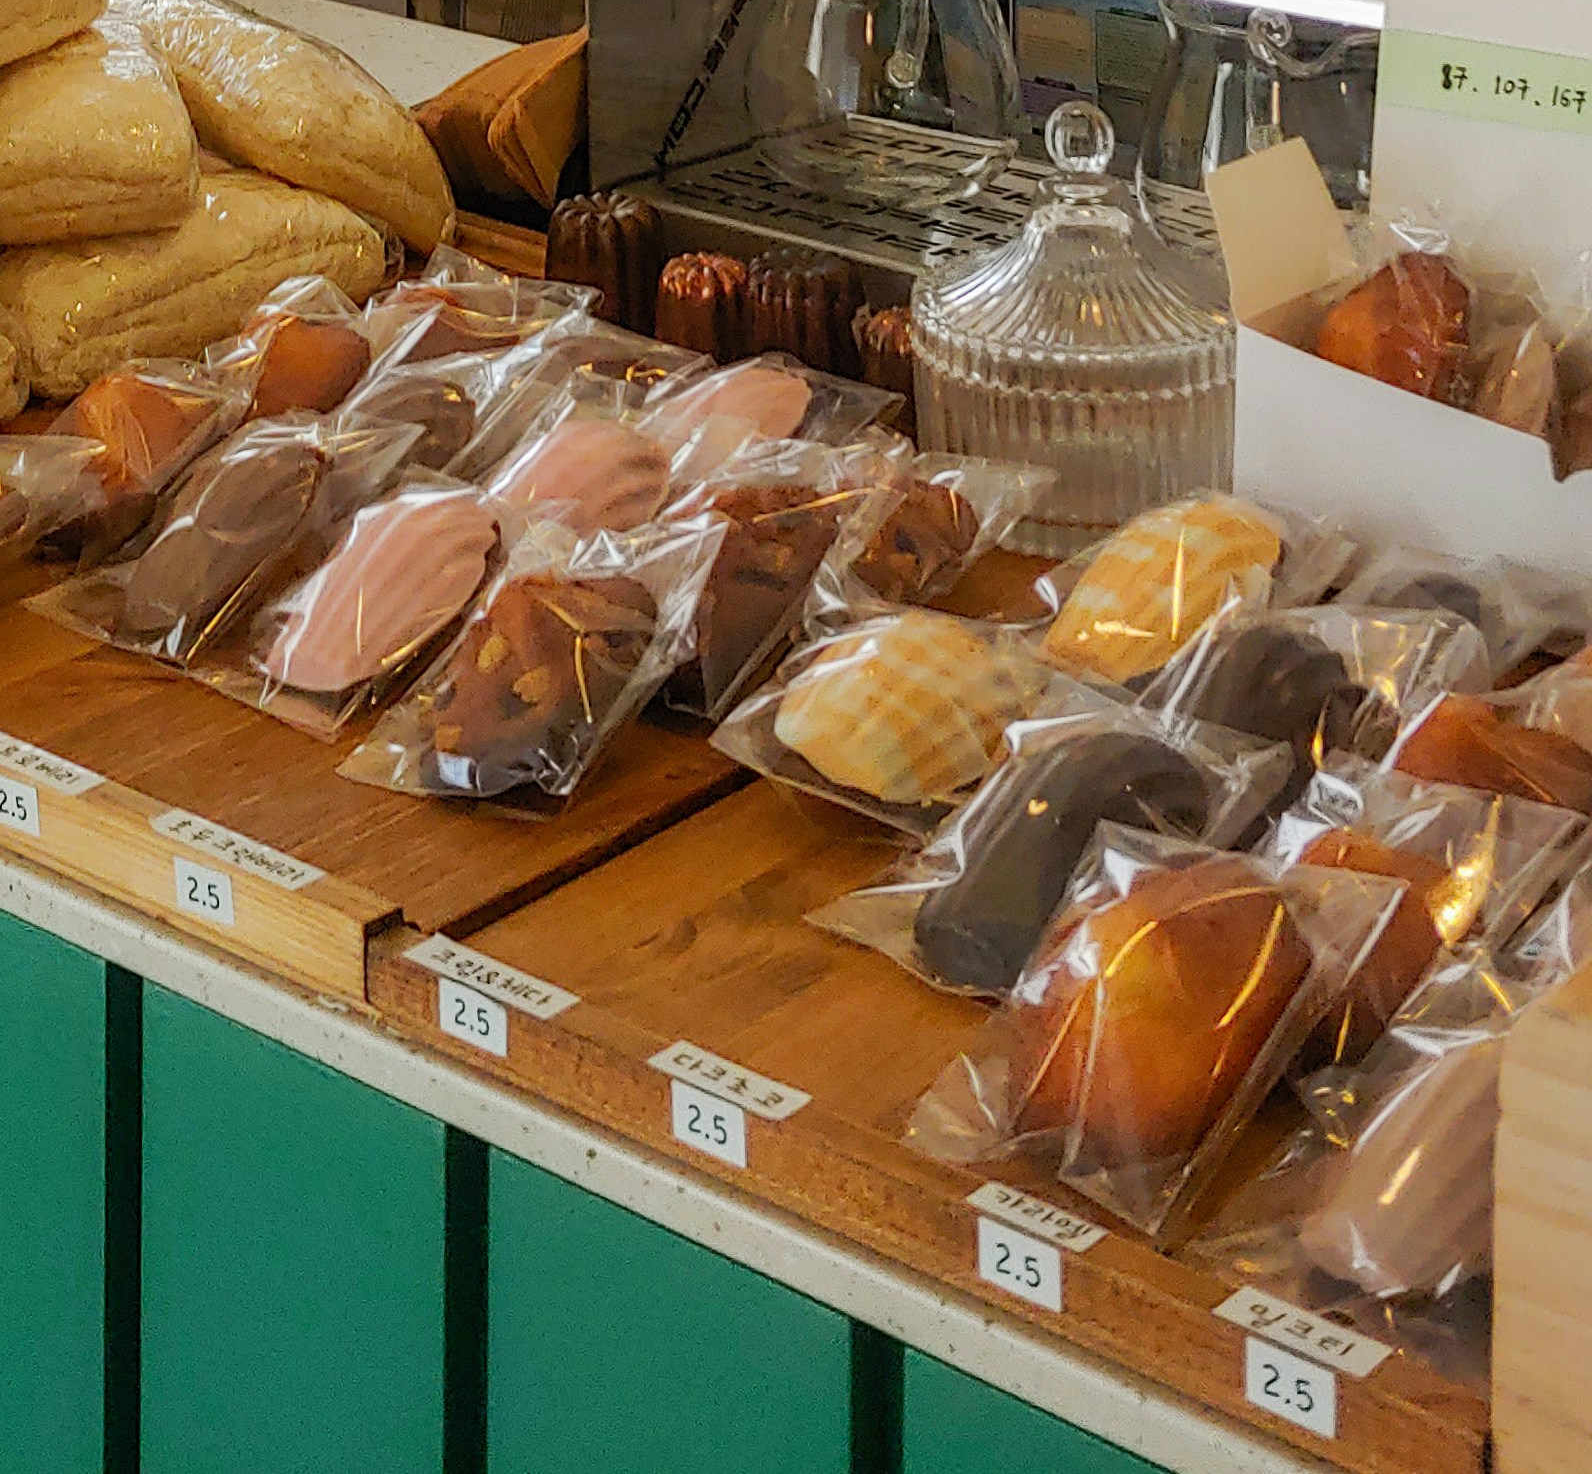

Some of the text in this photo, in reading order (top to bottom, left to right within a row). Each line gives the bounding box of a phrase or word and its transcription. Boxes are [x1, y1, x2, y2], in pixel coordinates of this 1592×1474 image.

[186, 876, 220, 910] 2.5
[454, 998, 490, 1036] 2.5
[673, 1051, 786, 1108] 다크초코
[687, 1104, 728, 1146] 2.5
[994, 1242, 1042, 1289] 2.5
[1262, 1363, 1314, 1413] 2.5
